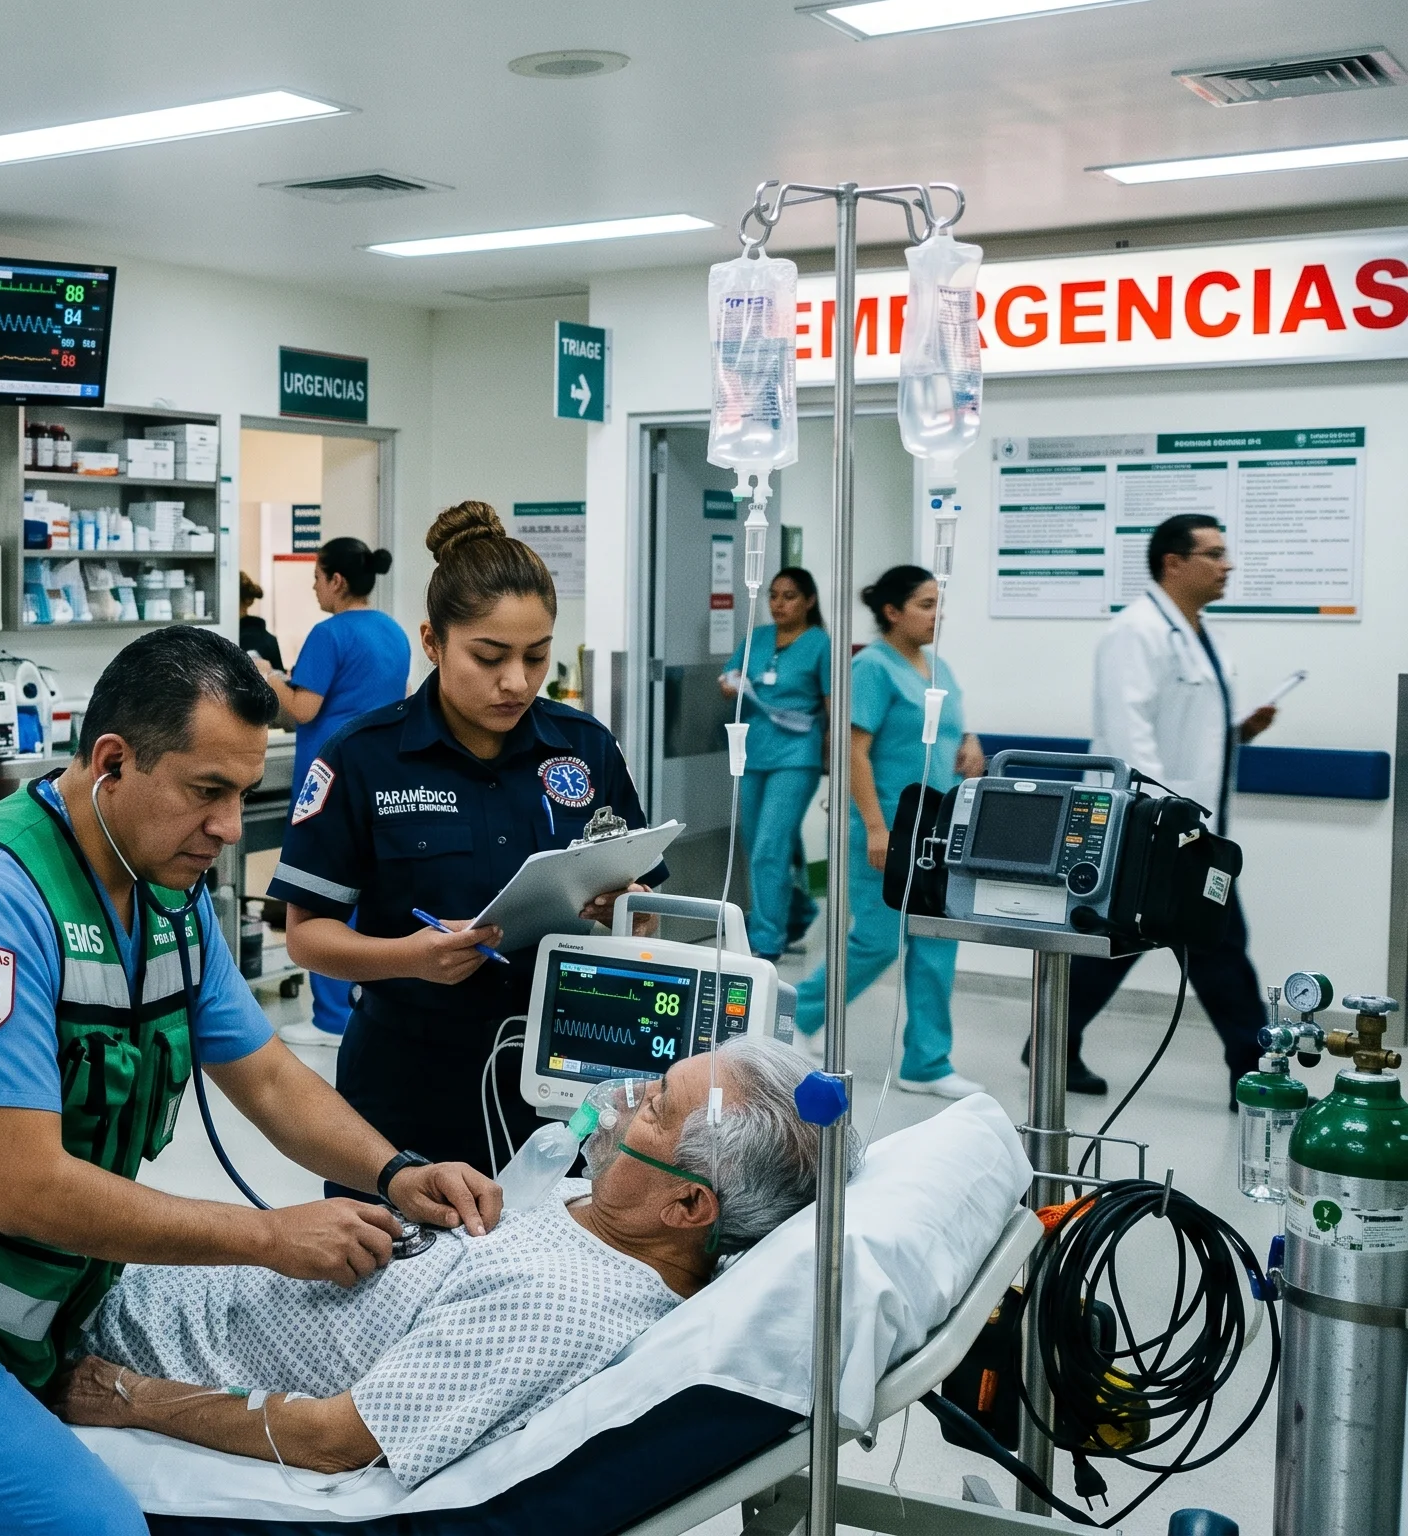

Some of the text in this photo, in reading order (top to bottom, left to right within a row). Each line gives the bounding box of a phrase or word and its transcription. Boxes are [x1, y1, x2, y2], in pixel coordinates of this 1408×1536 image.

[65, 285, 84, 303] 88
[64, 308, 82, 326] 84
[562, 338, 601, 361] TRIAGE
[283, 371, 365, 402] URGENCIAS
[63, 921, 105, 955] EMS
[654, 992, 680, 1016] 88
[651, 1036, 675, 1059] 94
